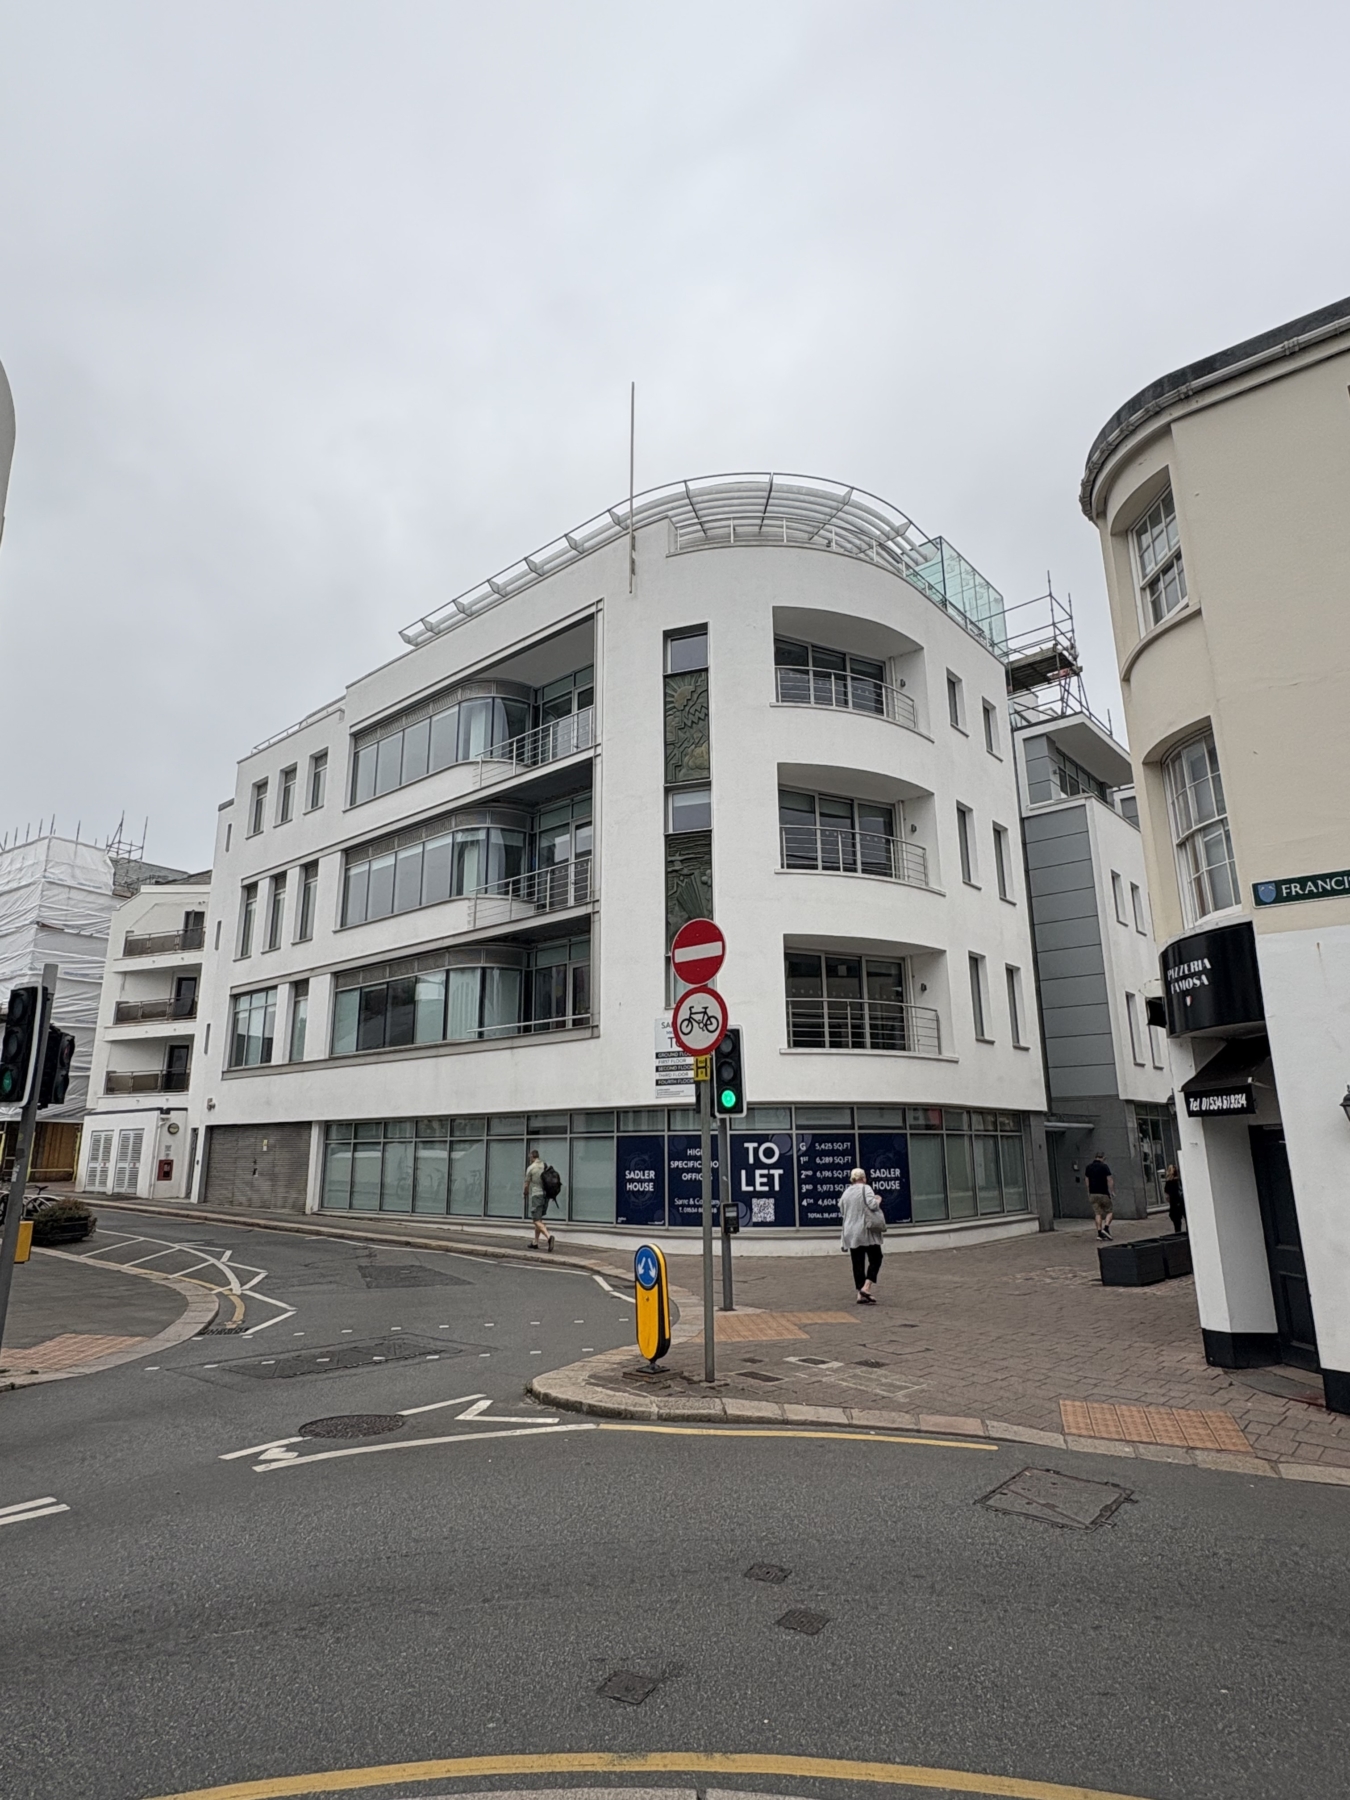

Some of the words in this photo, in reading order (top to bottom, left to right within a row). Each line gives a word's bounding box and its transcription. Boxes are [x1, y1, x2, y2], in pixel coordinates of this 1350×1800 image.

[1282, 876, 1350, 896] FRANCI
[1167, 958, 1212, 980] PIZZERIA
[1170, 974, 1209, 994] FAMOSA
[1190, 1098, 1200, 1111] Tel
[1202, 1096, 1222, 1110] 01534
[800, 1142, 806, 1150] G
[833, 1142, 851, 1151] SQ.FT
[743, 1142, 780, 1164] TO
[800, 1156, 808, 1164] 1ST
[816, 1156, 833, 1164] 6,289
[834, 1156, 852, 1164] SQ.FT
[625, 1170, 655, 1179] SADLER
[801, 1170, 813, 1179] 2ND
[816, 1170, 832, 1179] 6,196
[833, 1170, 850, 1178] SQ.FT
[870, 1168, 900, 1177] SADLER
[741, 1169, 784, 1192] LET
[872, 1180, 900, 1190] HOUSE
[626, 1182, 654, 1191] HOUSE
[801, 1184, 813, 1193] 3RD
[817, 1184, 834, 1192] 5,973
[695, 1198, 720, 1208] Coany
[818, 1199, 836, 1207] 4,604
